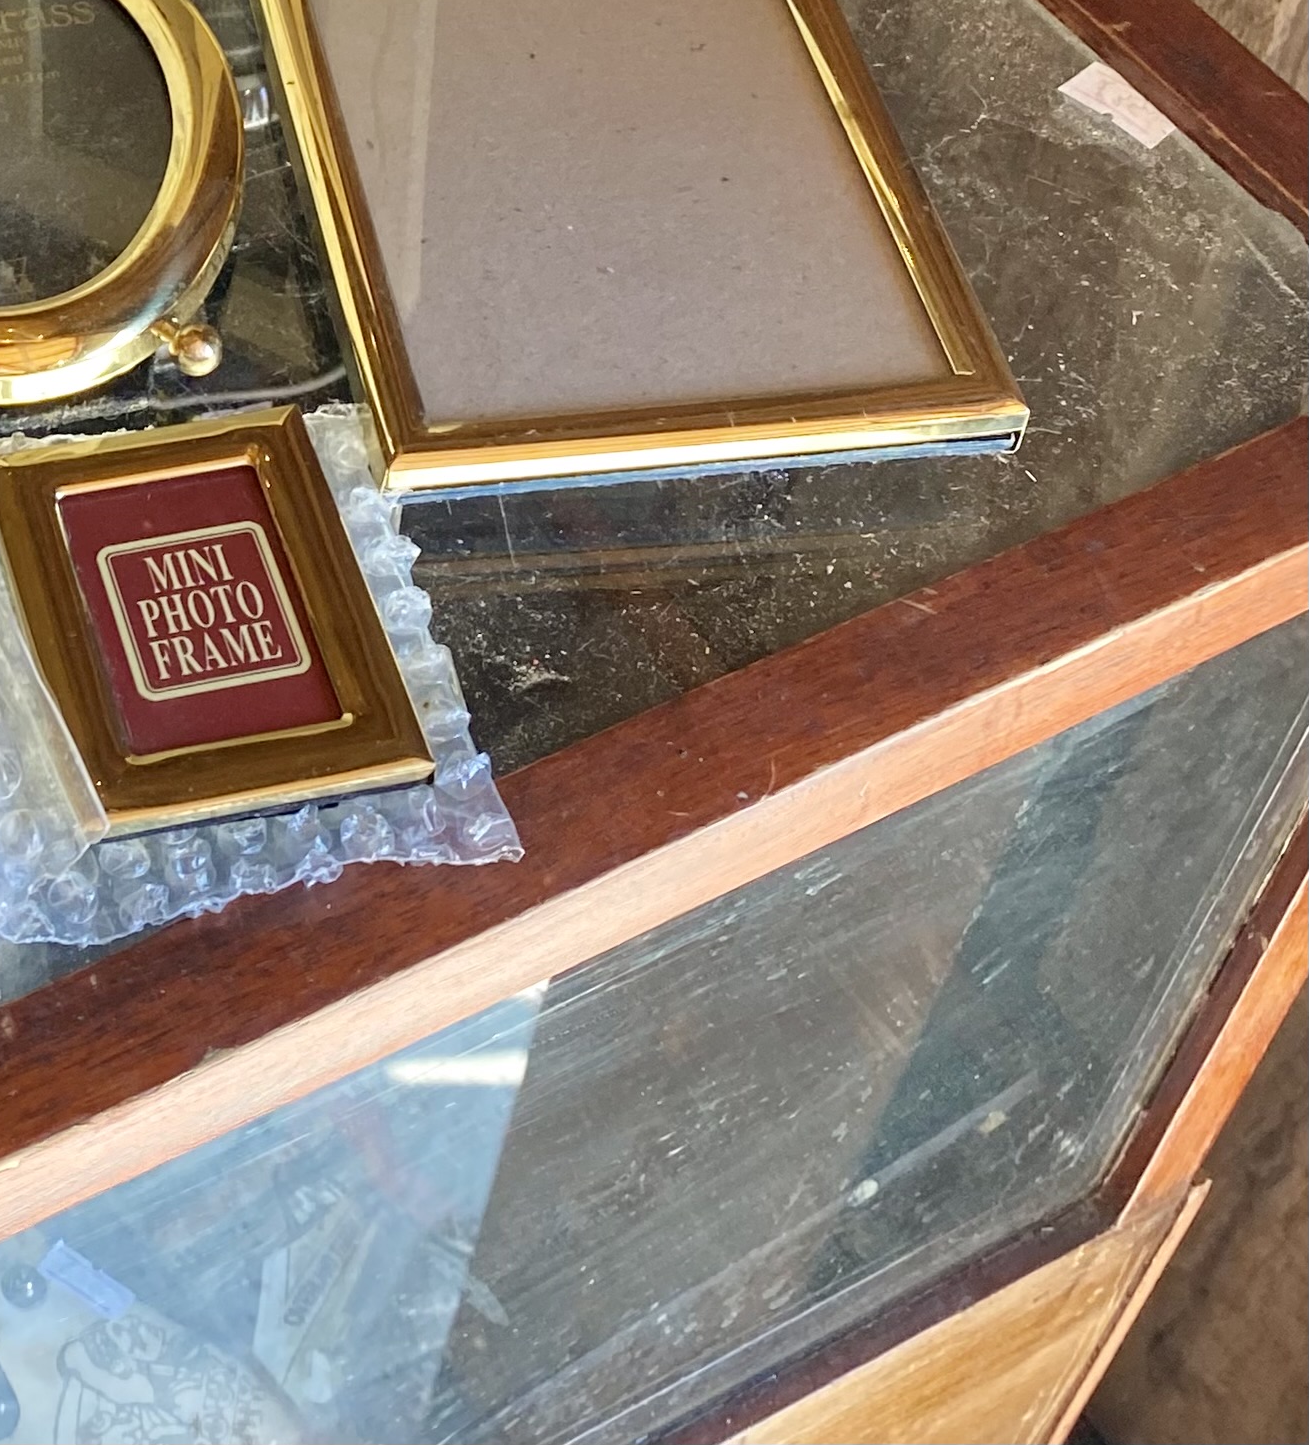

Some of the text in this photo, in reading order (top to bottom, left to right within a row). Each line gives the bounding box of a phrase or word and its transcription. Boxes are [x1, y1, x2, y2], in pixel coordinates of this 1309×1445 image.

[143, 544, 234, 593] MINI
[137, 580, 264, 638] PHOTO
[149, 620, 282, 680] FRAME
